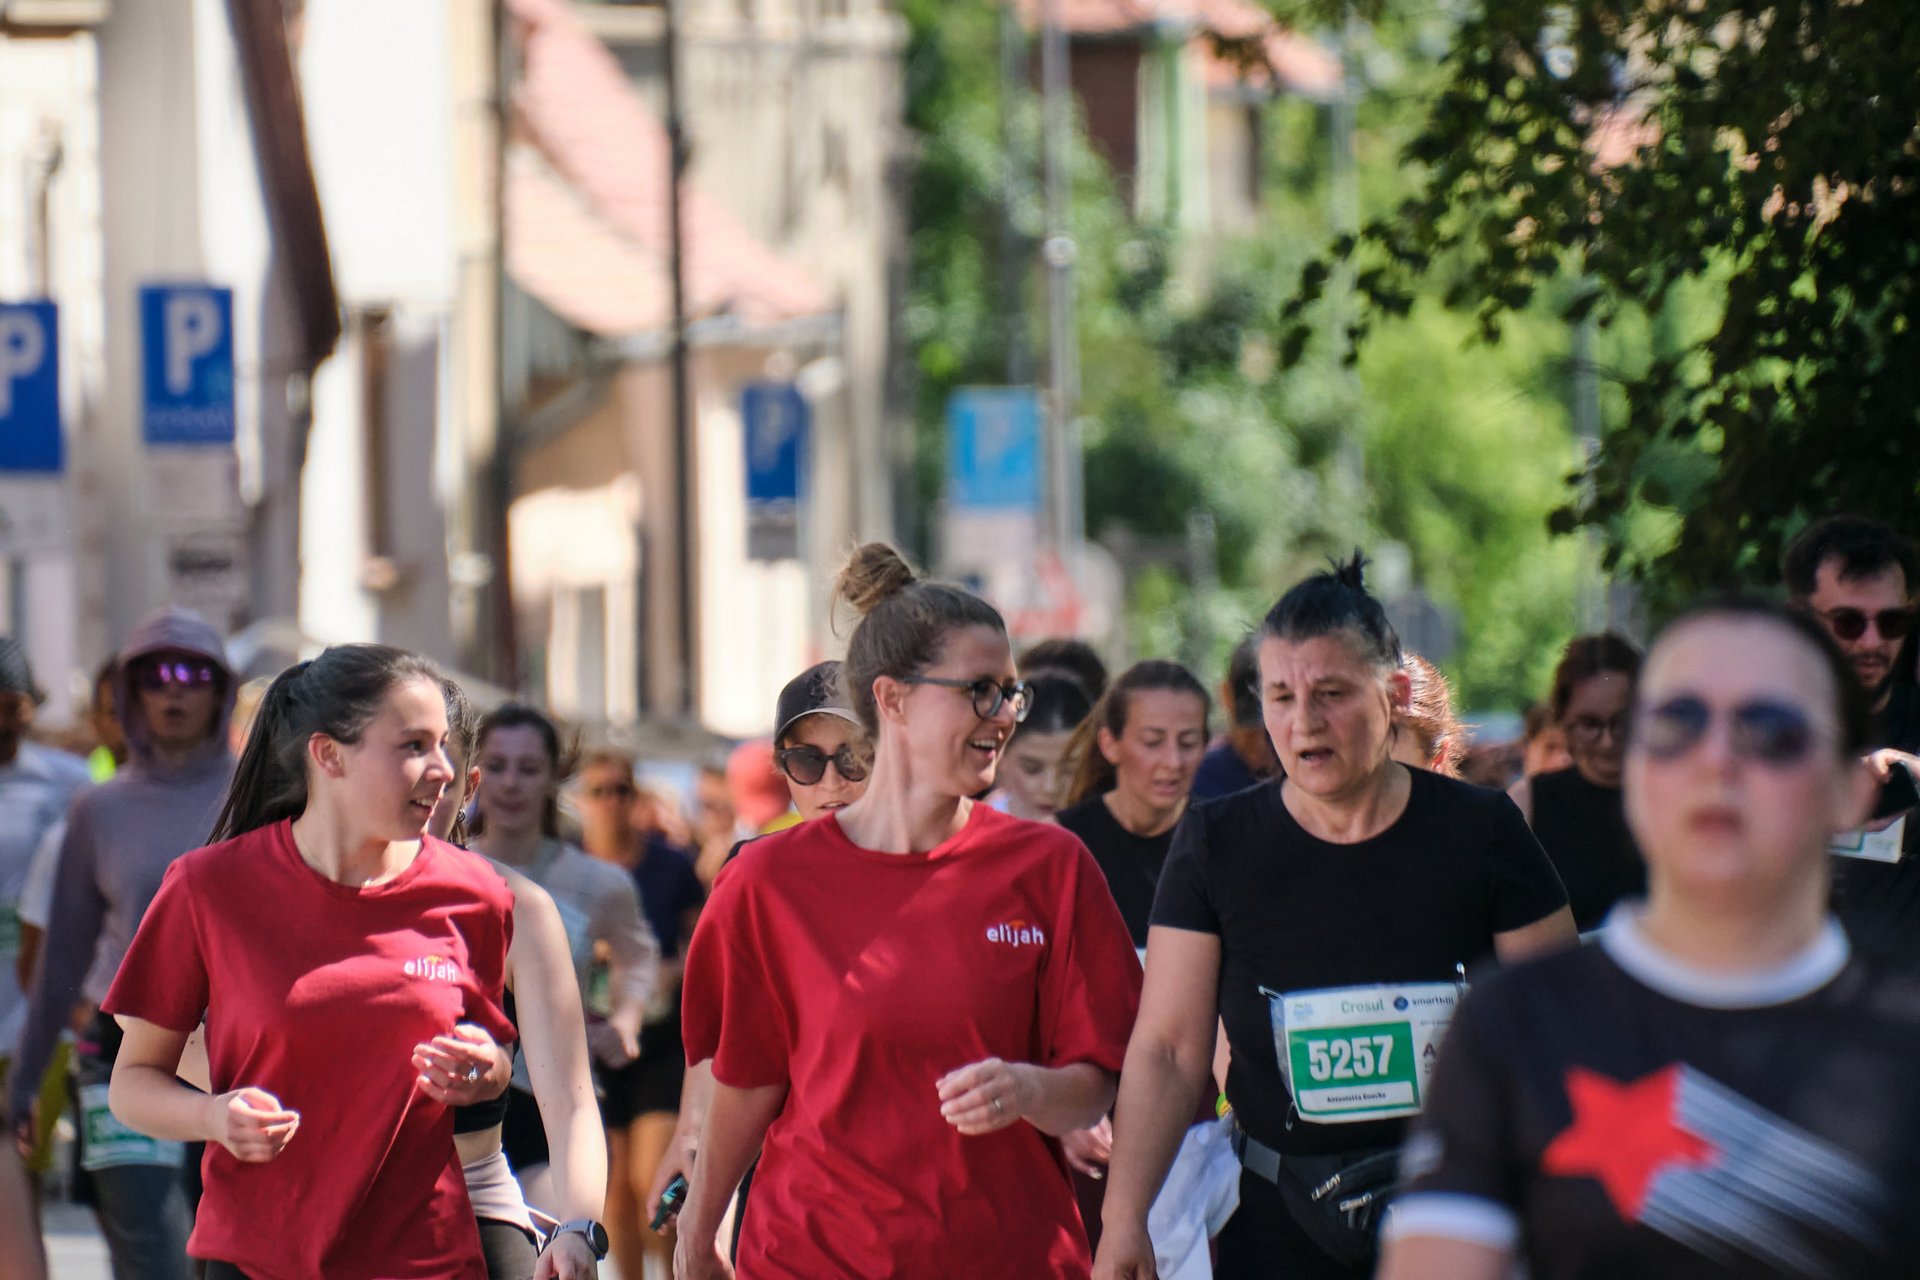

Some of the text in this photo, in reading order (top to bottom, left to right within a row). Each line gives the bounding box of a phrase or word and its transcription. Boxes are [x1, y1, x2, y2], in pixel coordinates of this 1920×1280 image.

[164, 293, 222, 396] P
[0, 309, 45, 419] P
[986, 921, 1044, 948] elijah
[403, 957, 456, 982] elijah
[1341, 998, 1384, 1014] Crosul
[1308, 1034, 1394, 1081] 5257
